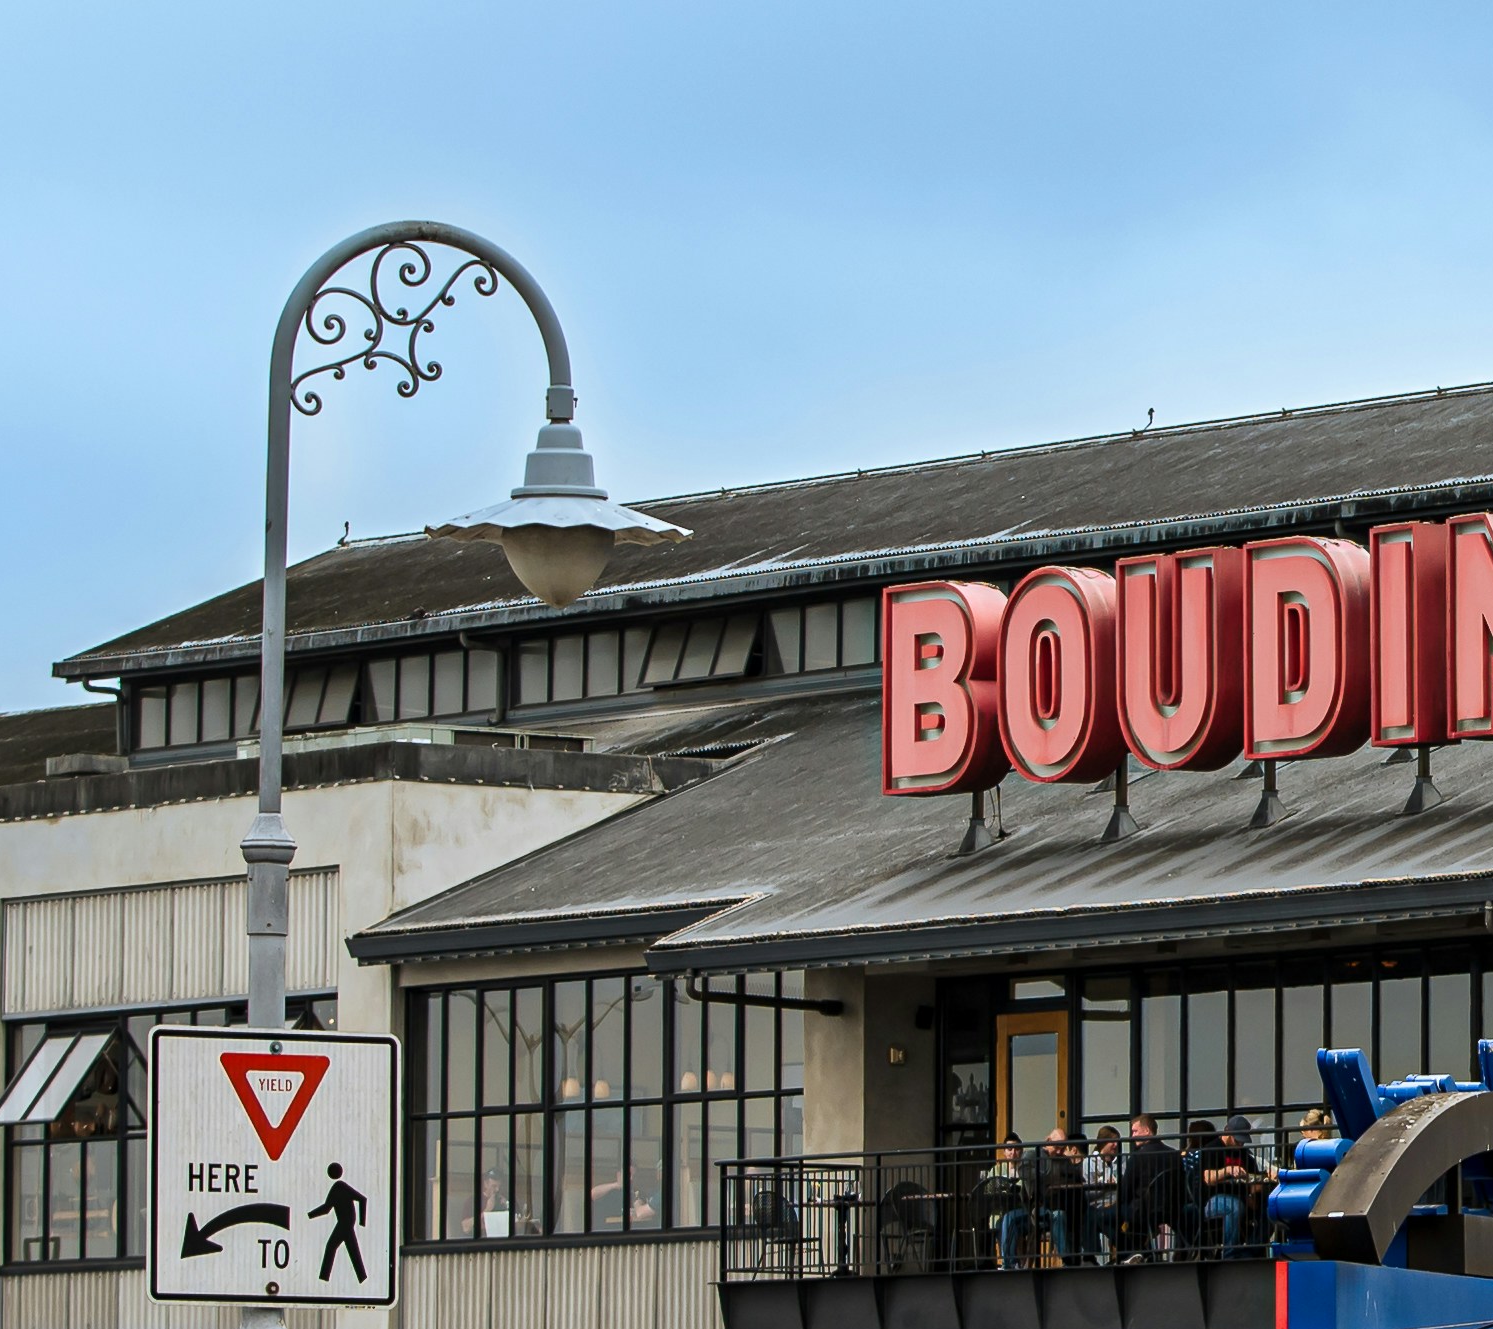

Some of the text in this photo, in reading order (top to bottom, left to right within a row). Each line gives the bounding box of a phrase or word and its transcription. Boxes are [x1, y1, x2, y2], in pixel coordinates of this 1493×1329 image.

[258, 1078, 293, 1092] YIELD
[188, 1162, 259, 1193] HERE
[258, 1239, 290, 1269] TO
